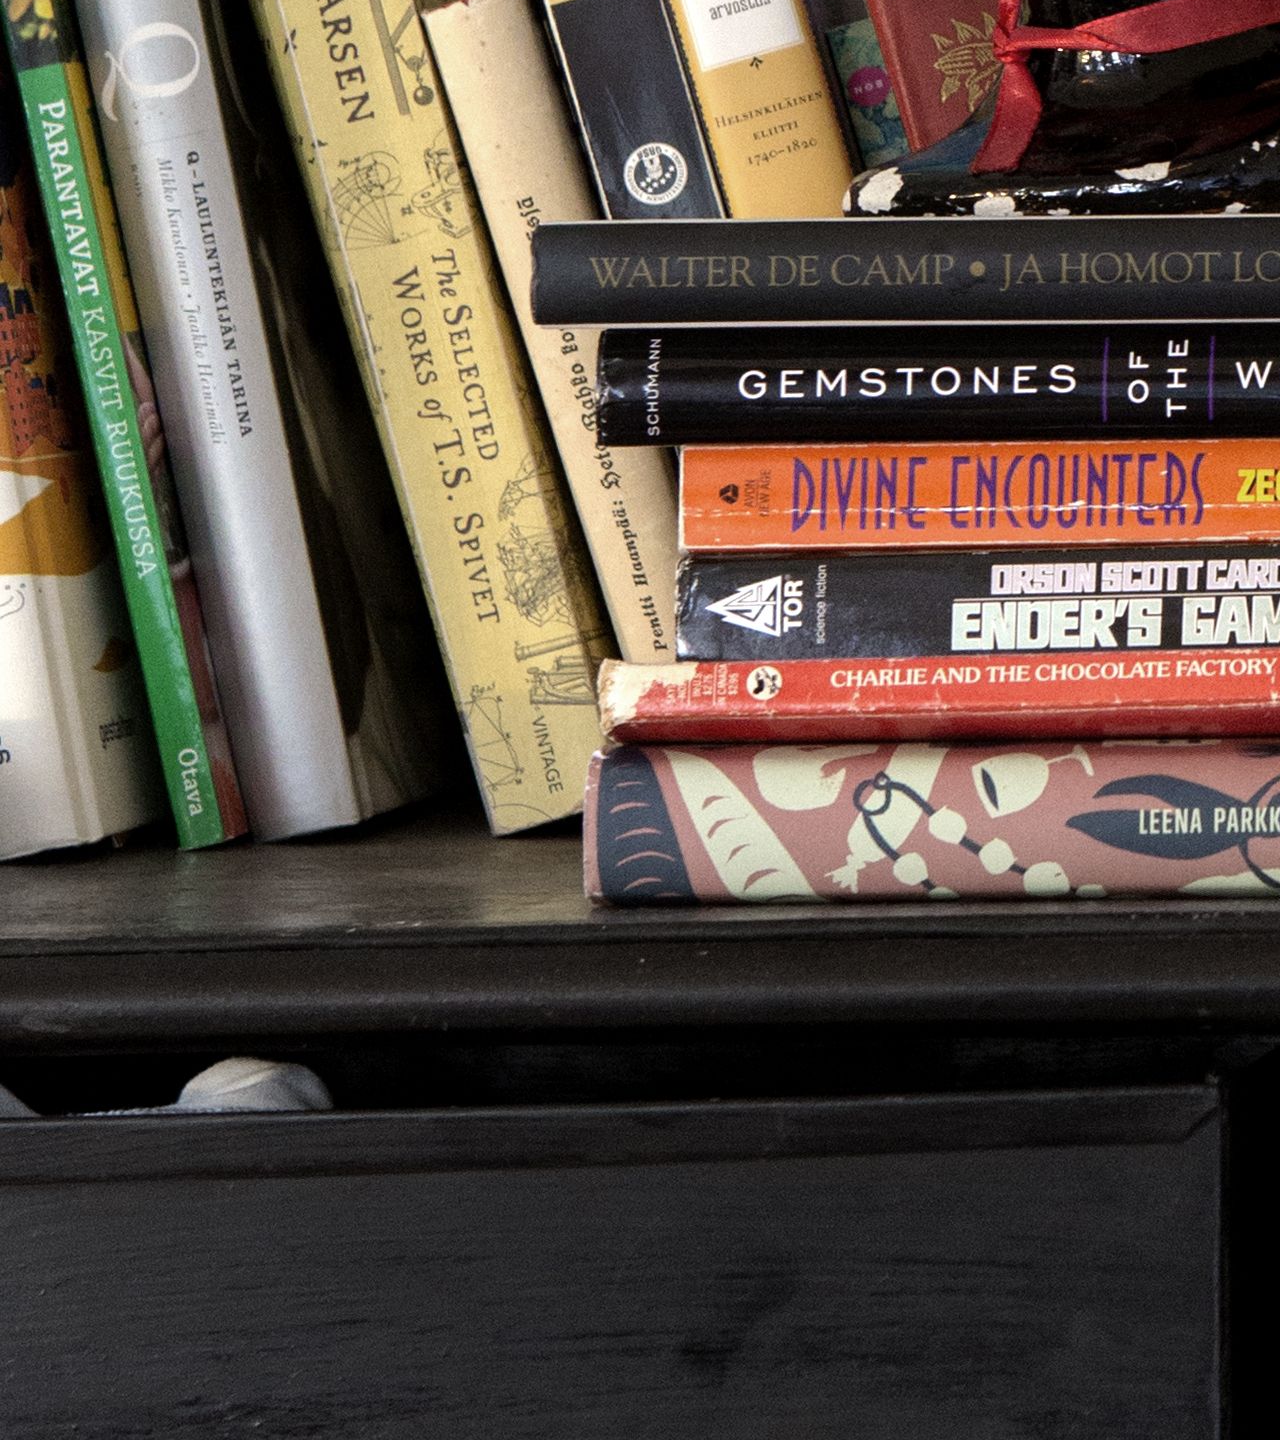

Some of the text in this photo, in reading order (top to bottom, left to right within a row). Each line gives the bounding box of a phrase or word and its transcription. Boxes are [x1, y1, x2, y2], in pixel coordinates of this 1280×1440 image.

[589, 254, 753, 292] WALTER
[767, 254, 821, 288] DE
[830, 252, 956, 289] CAMP
[999, 250, 1047, 292] JA
[1059, 249, 1222, 286] HOMOT
[36, 98, 154, 581] PARANTAVAT KASVIT RUUKUSSA
[430, 246, 502, 463] The SELECTED
[226, 355, 253, 439] TARINA
[646, 336, 663, 438] SCHUMANN
[737, 363, 1079, 401] GEMSTONES
[1127, 351, 1151, 405] OF
[1166, 339, 1191, 419] THE
[391, 265, 503, 626] WORKS of T.S. SPIVET
[791, 454, 928, 535] DIVINE
[948, 450, 1207, 533] ENCOUNTERS
[638, 577, 670, 653] Pentti
[783, 577, 804, 631] TOR
[990, 562, 1098, 596] ORSON
[1100, 558, 1206, 594] SCOTT
[950, 596, 1166, 653] ENDER'S
[830, 664, 928, 691] CHARLIE
[932, 663, 982, 689] AND
[985, 661, 1032, 688] THE
[1035, 658, 1172, 685] CHOCOLATE
[1175, 656, 1280, 680] FACTORY
[177, 745, 204, 818] Otava
[531, 713, 565, 795] VINTAGE
[1138, 807, 1204, 836] LEENA
